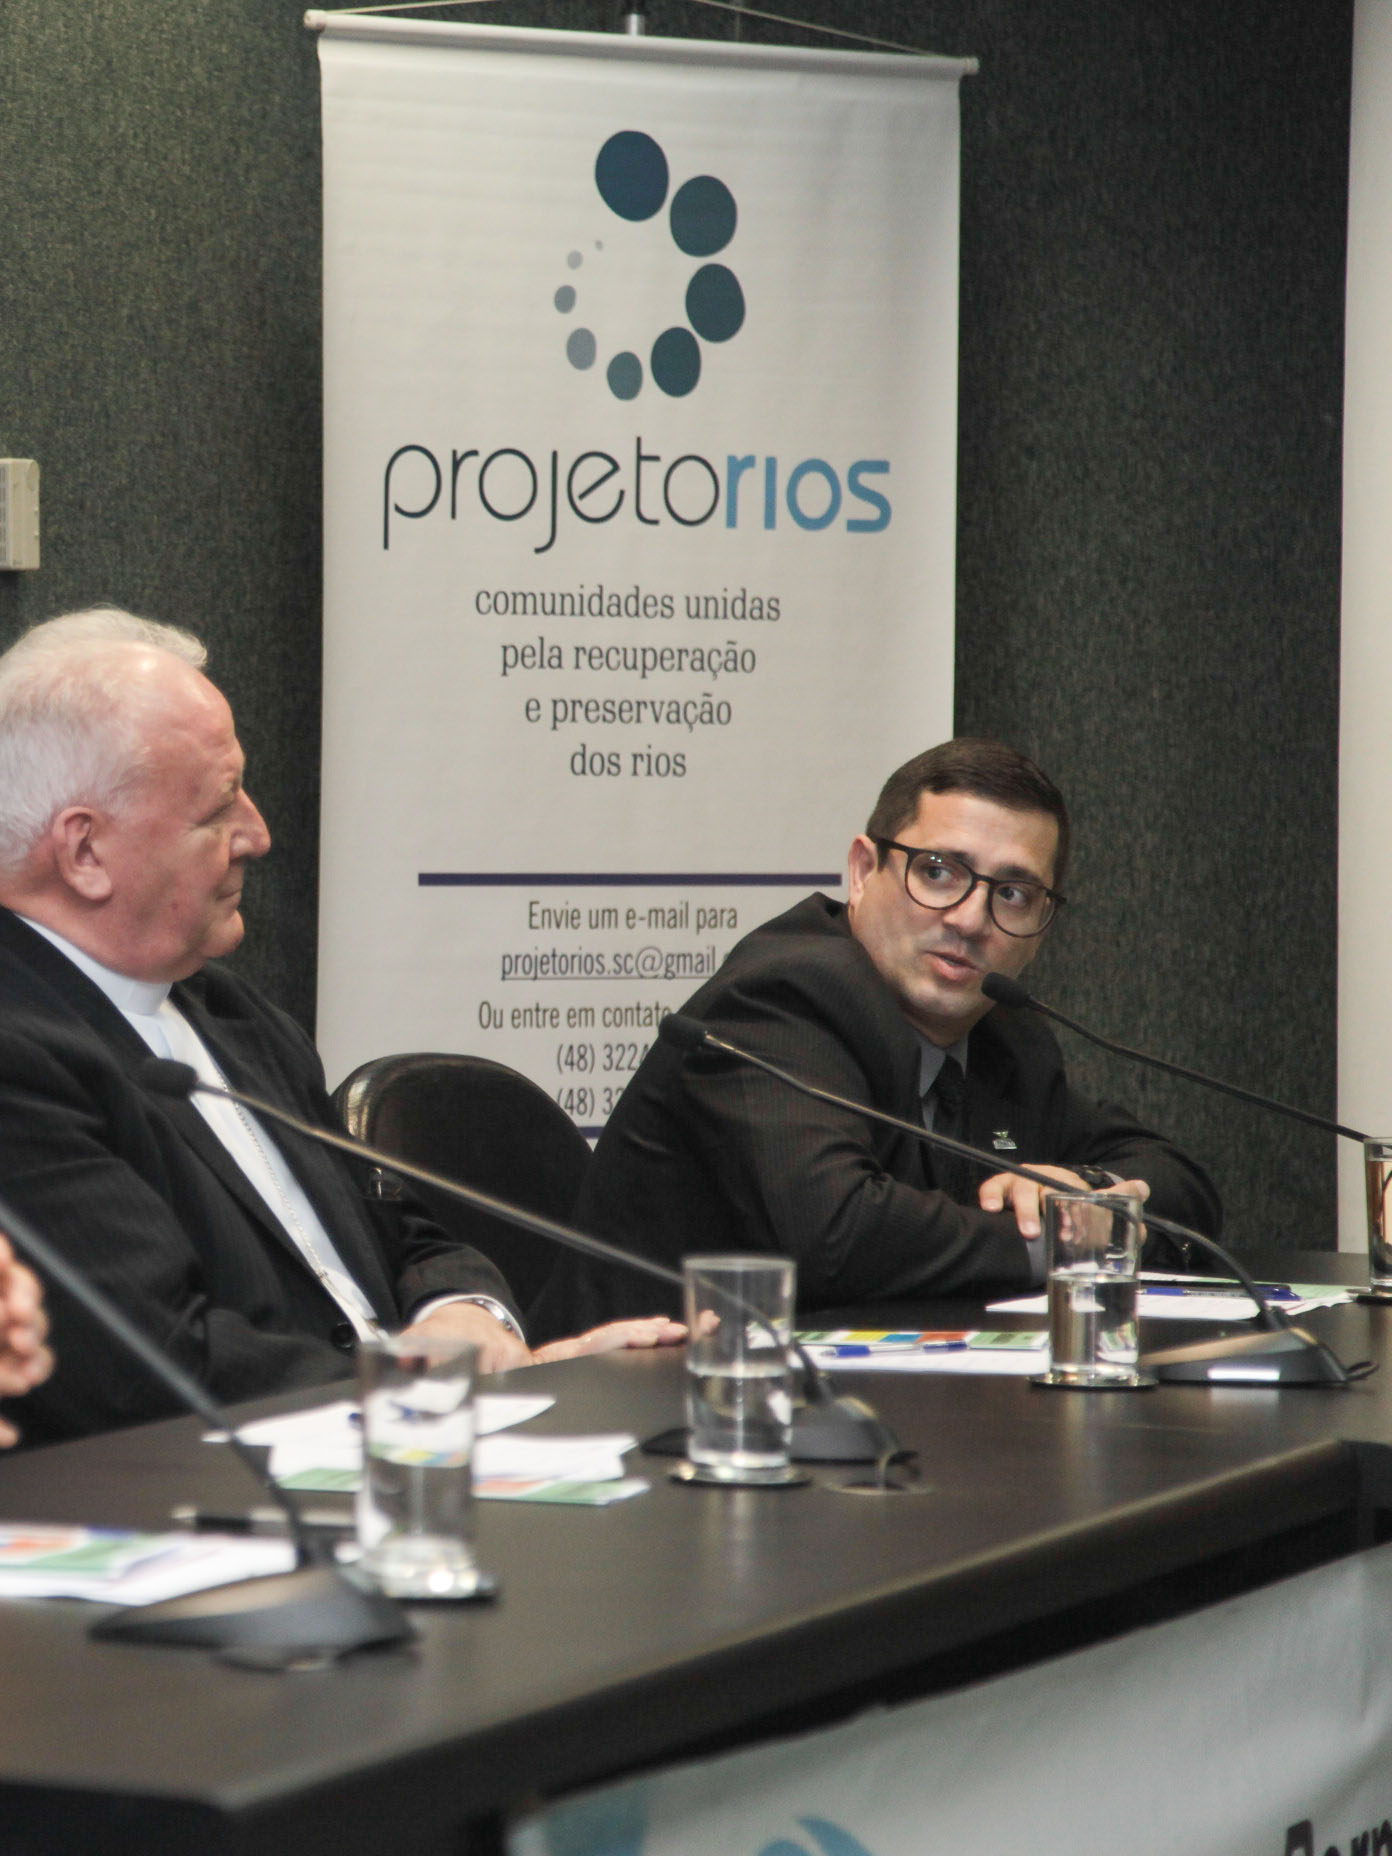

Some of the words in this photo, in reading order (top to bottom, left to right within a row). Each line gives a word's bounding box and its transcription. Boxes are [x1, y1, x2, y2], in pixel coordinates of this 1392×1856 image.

[474, 585, 675, 619] comunidades
[684, 588, 781, 622] unidas
[500, 637, 564, 676] pela
[573, 641, 757, 680] recuperação
[524, 698, 542, 723] e
[551, 692, 733, 732] preservação
[569, 743, 622, 777] dos
[630, 745, 688, 778] rios
[528, 900, 581, 930] Envie
[588, 907, 619, 930] um
[625, 901, 690, 930] e-mail
[696, 906, 738, 935] para
[501, 946, 728, 981] projetorios.sc@gmail
[478, 1001, 504, 1030] Ou
[511, 1002, 560, 1030] entre
[566, 1006, 596, 1029] em
[557, 1043, 596, 1075] (48)
[558, 1086, 596, 1118] (48)
